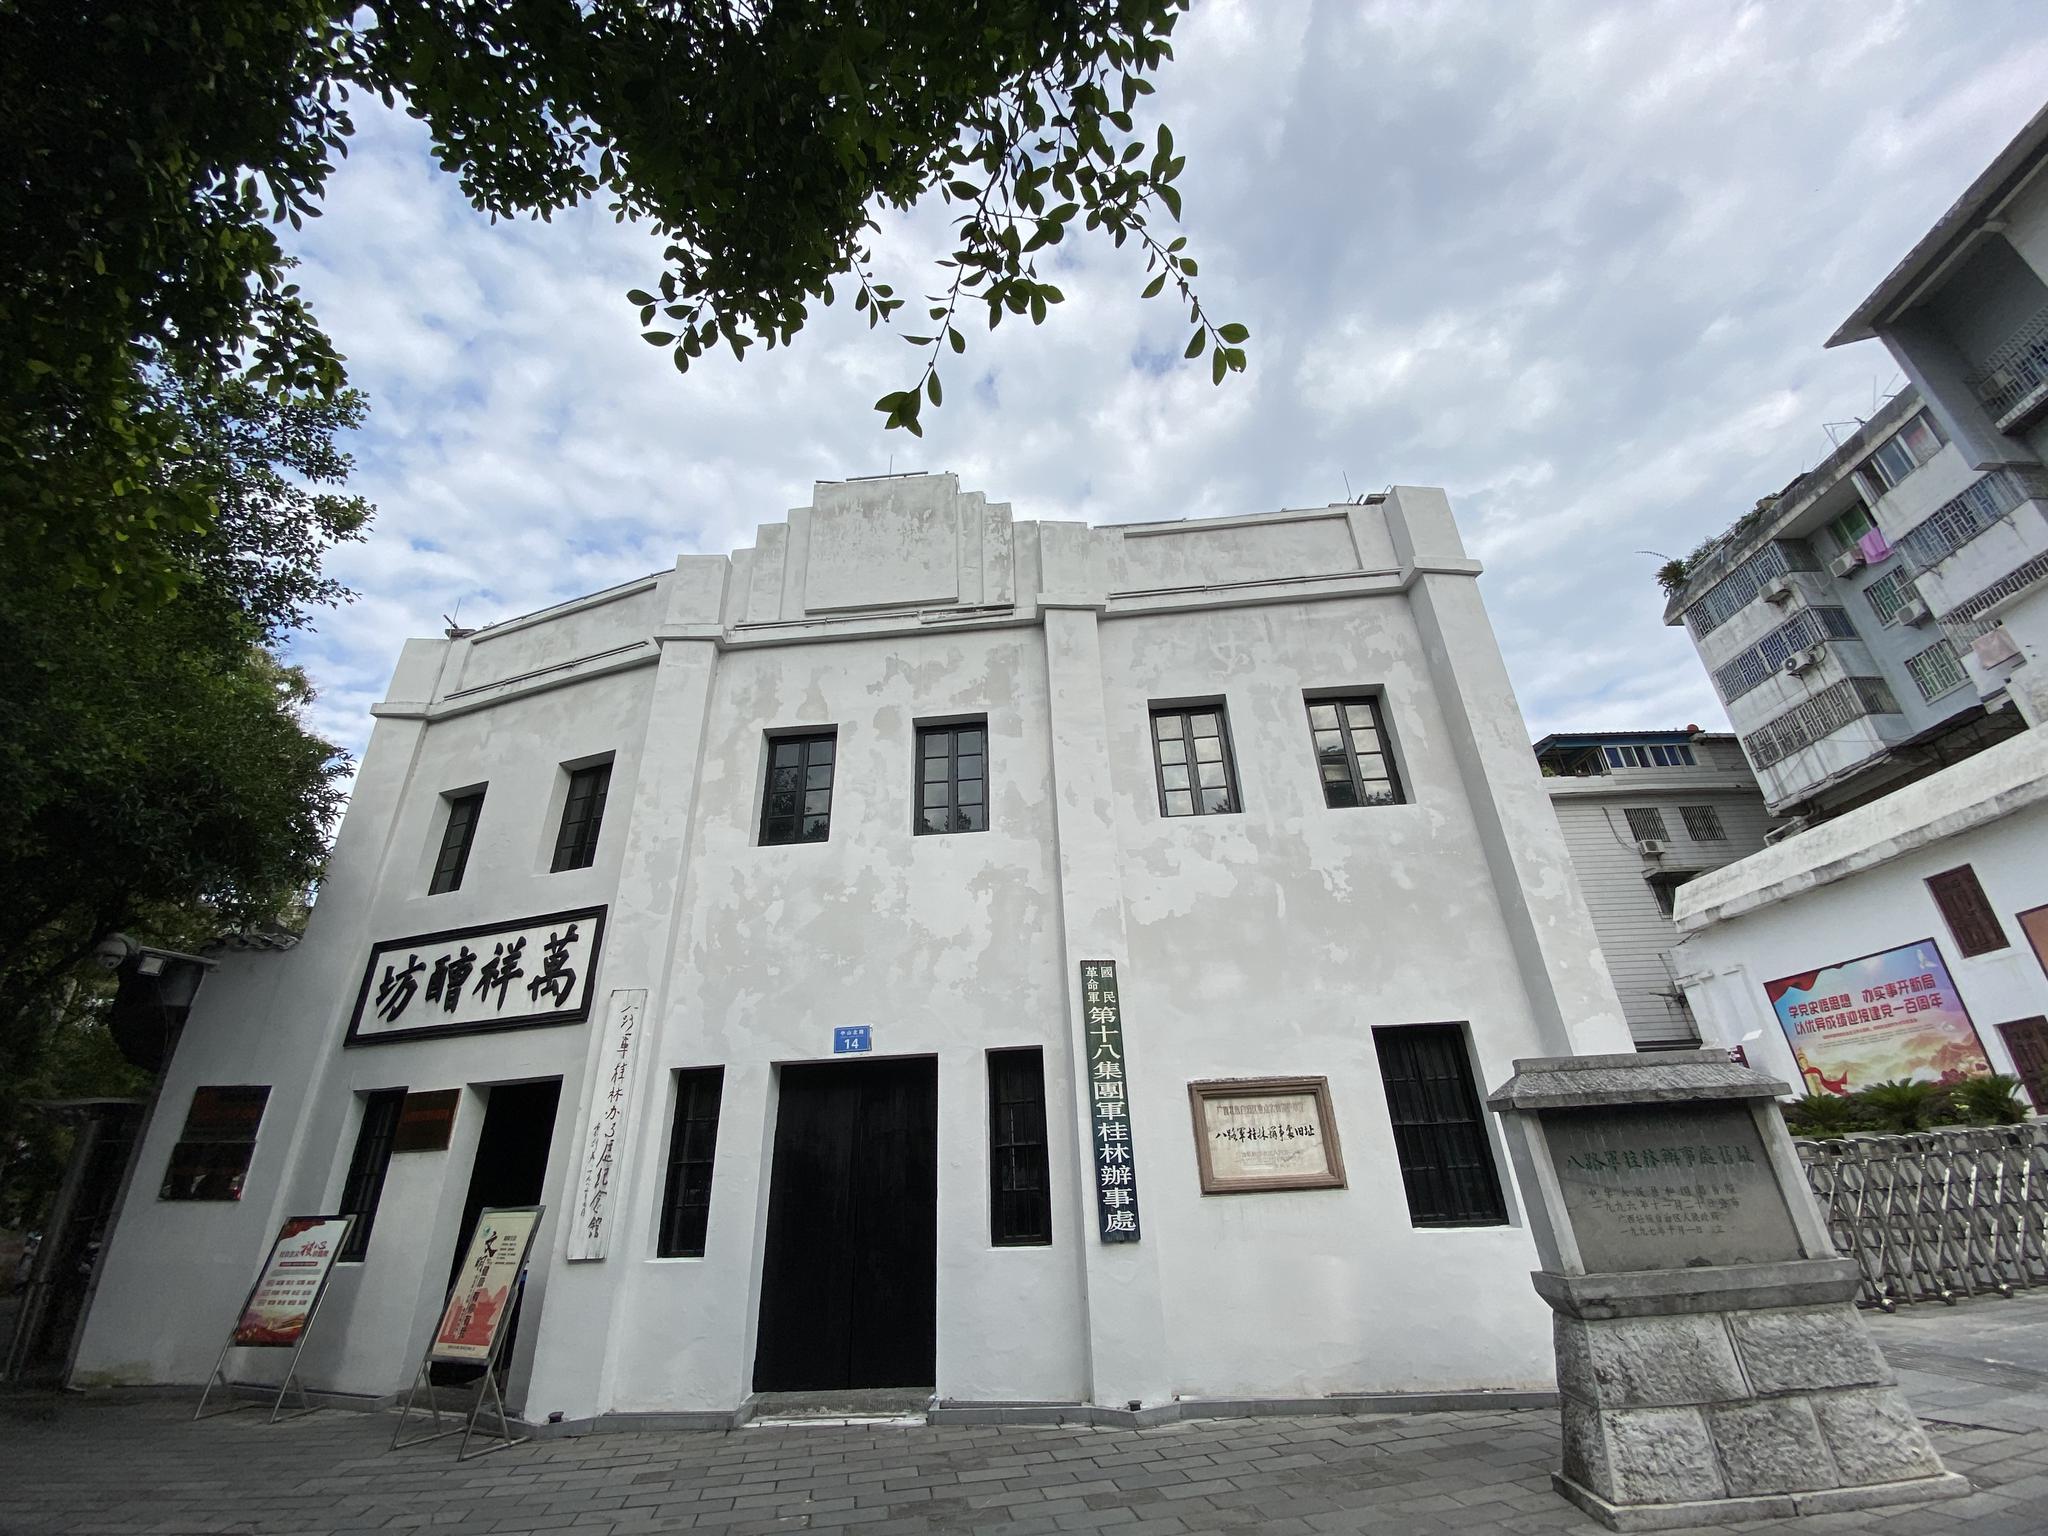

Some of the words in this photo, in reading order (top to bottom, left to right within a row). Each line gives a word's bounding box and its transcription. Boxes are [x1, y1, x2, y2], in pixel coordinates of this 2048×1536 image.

[1788, 993, 1853, 1019] 学党史悟思想
[1861, 973, 1937, 1003] 办实事开新局
[1794, 992, 1944, 1036] 以优异成绩迎接建党一百周年
[844, 1038, 859, 1049] 14
